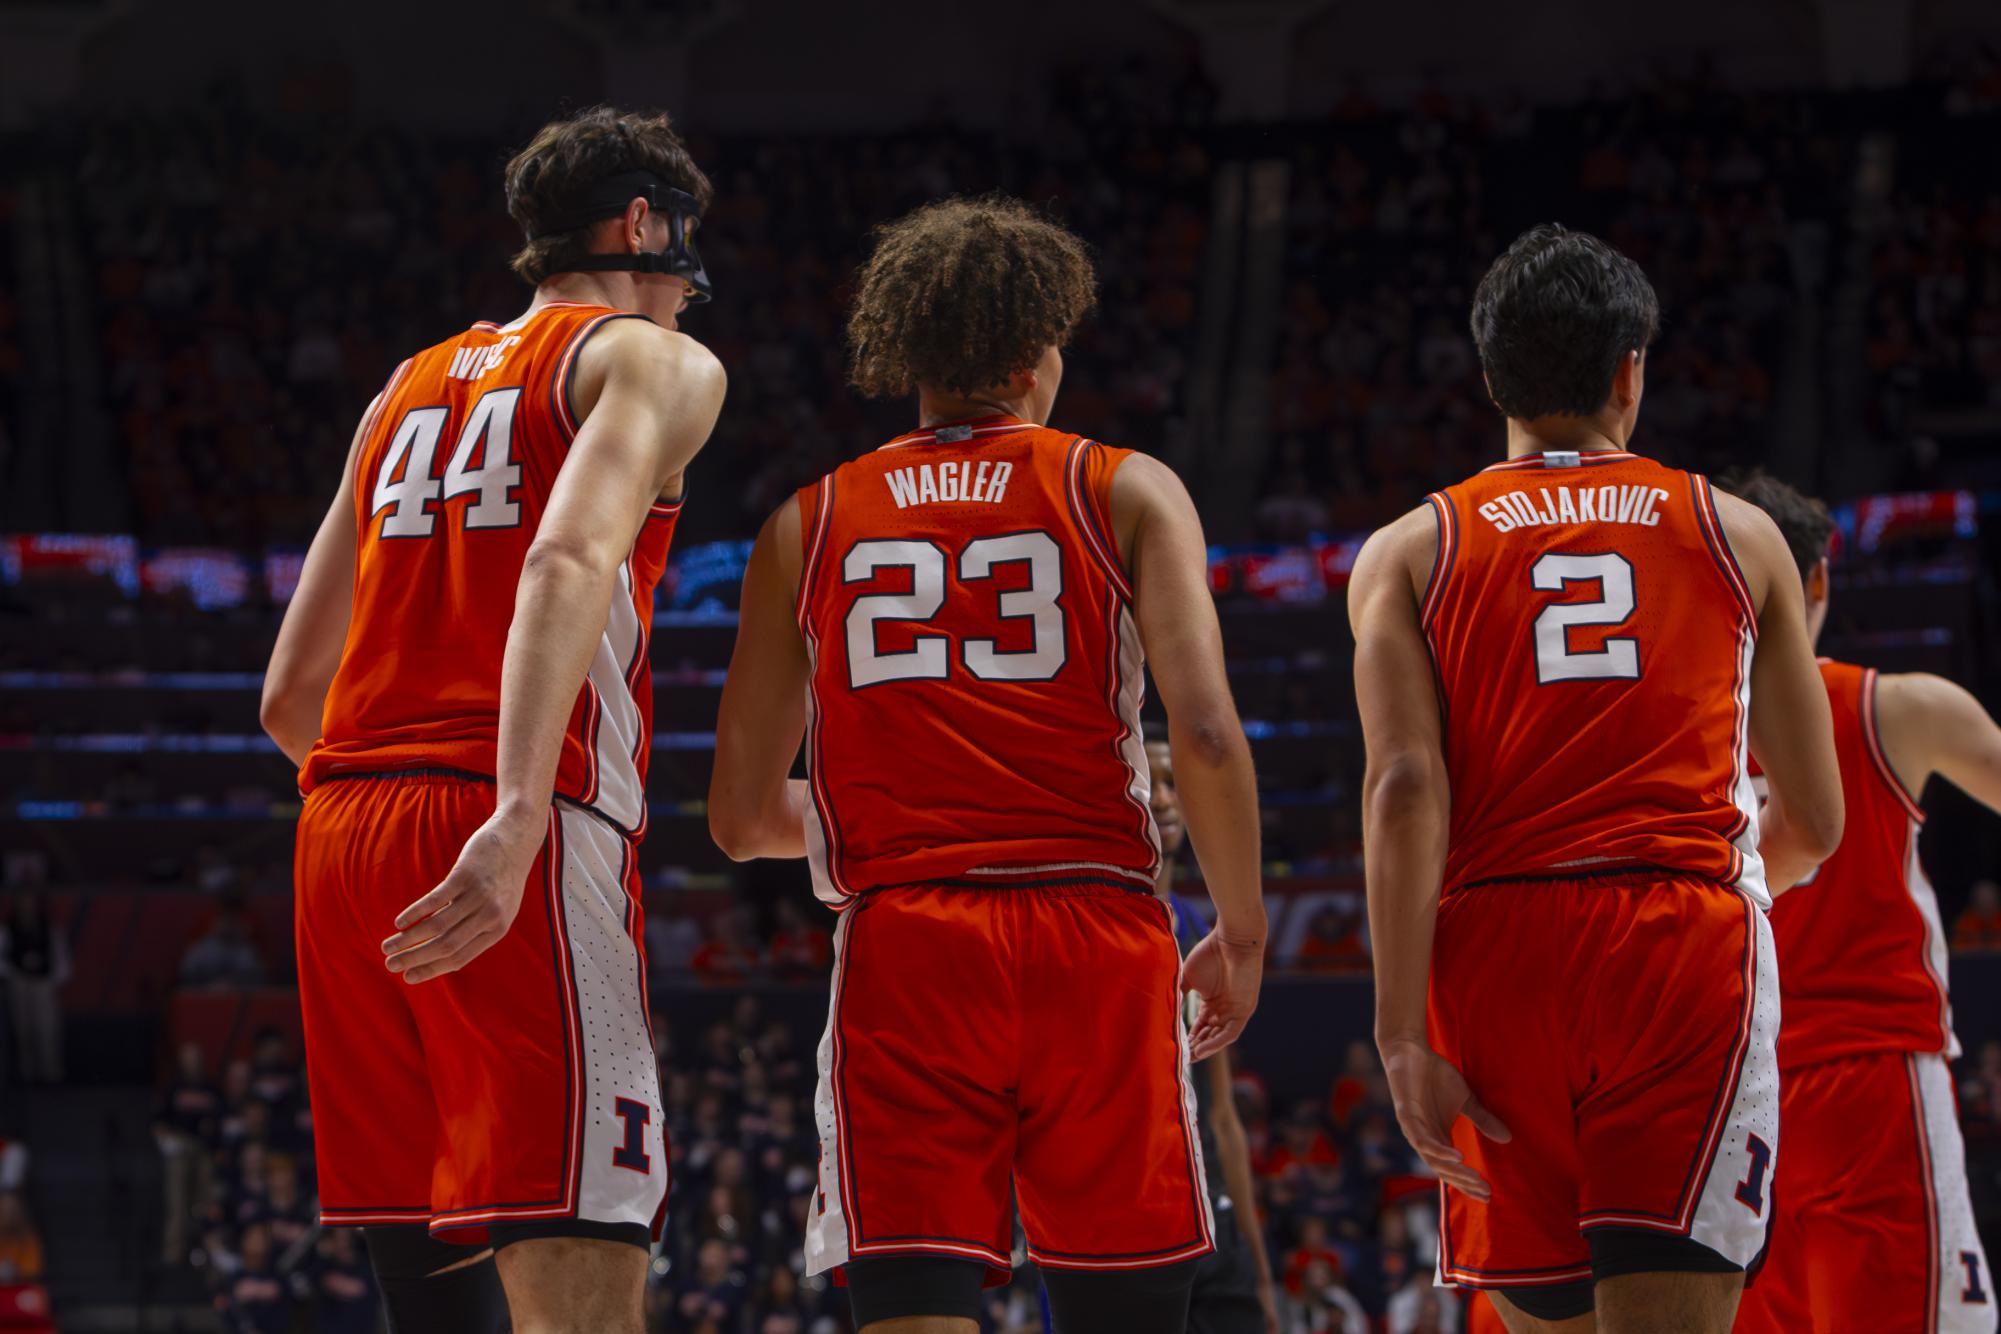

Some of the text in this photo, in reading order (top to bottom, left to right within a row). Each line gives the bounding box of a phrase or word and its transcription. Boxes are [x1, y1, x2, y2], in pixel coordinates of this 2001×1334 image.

[371, 386, 525, 540] 44
[884, 461, 1013, 508] WAGLER
[1478, 485, 1669, 533] STOJAKOVIC
[842, 528, 1068, 691] 23
[1531, 551, 1642, 686] 2
[612, 1095, 650, 1176] I
[1735, 1131, 1771, 1218] I
